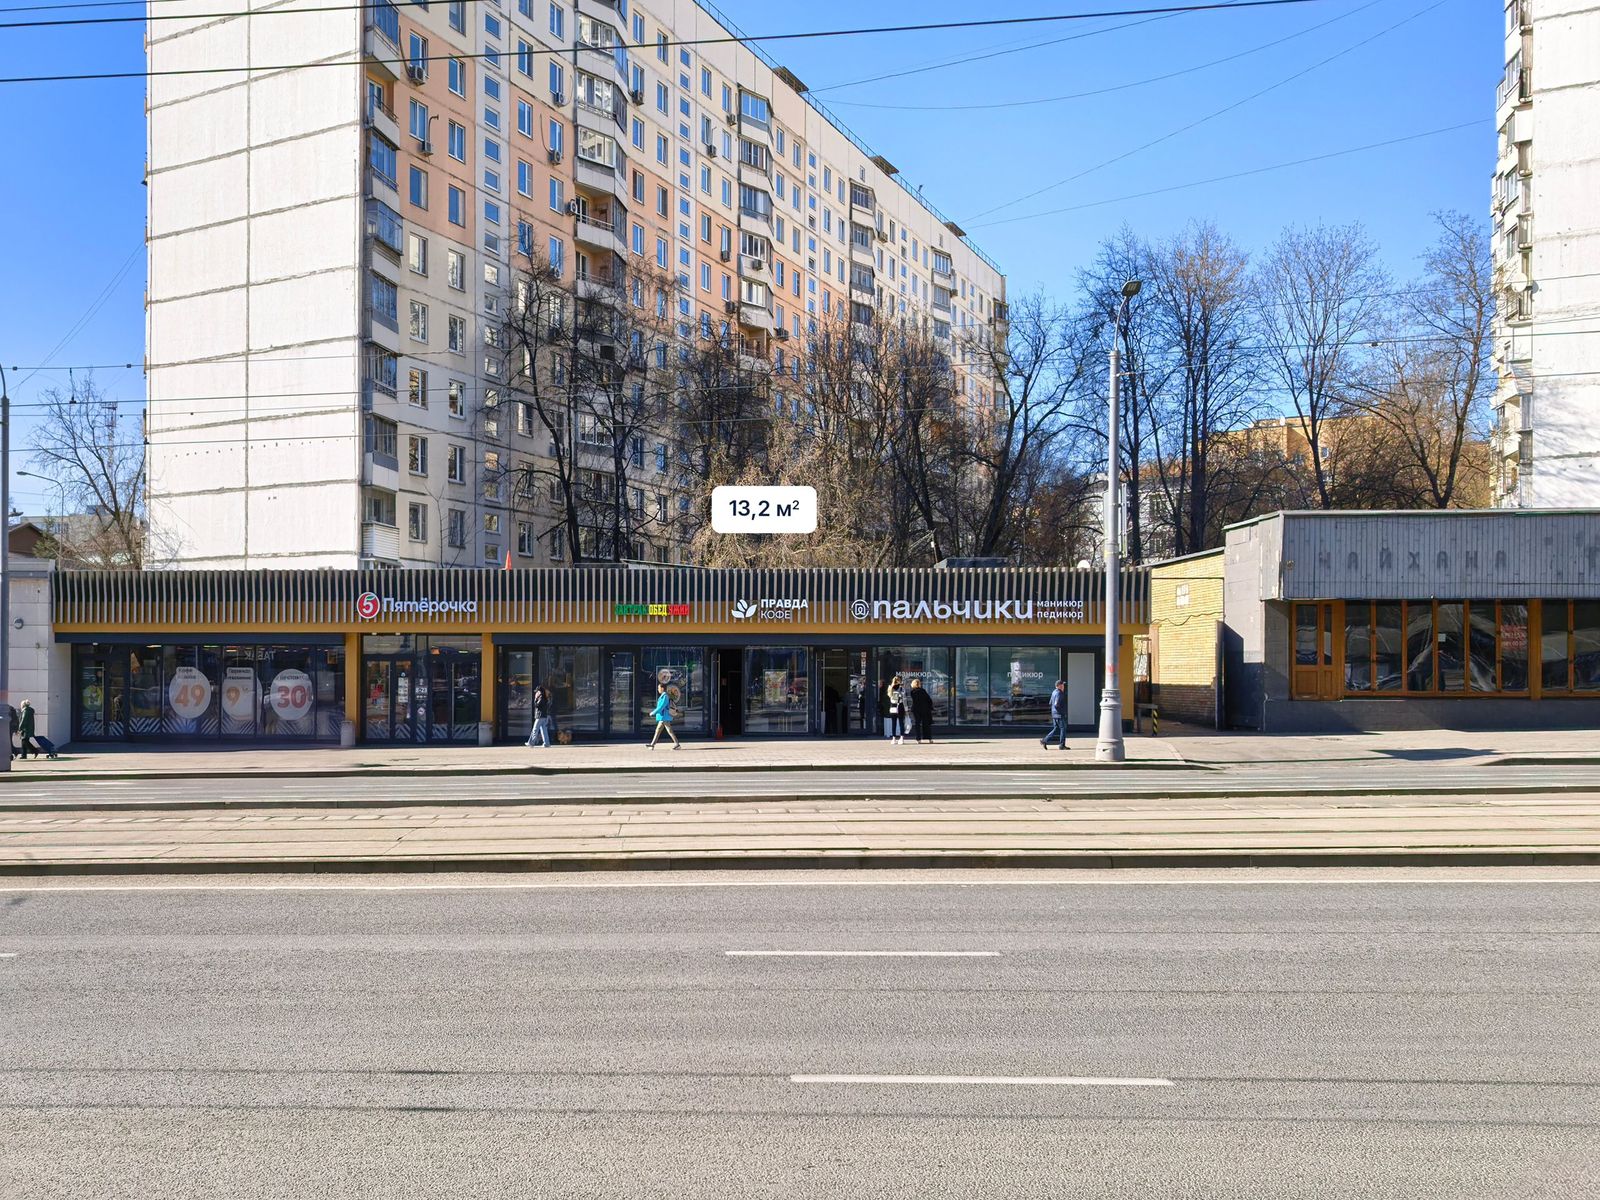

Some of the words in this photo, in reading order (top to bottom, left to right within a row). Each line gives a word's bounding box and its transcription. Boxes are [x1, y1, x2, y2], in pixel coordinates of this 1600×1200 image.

[1318, 547, 1507, 569] ЧАЙХАНА
[383, 597, 478, 616] Пятёрочка
[648, 604, 667, 616] ОБЕД
[760, 599, 809, 610] ПРАВДА
[873, 599, 1033, 619] пальчики
[1037, 600, 1084, 609] маникюр
[760, 610, 791, 619] КОФЕ
[1037, 610, 1084, 620] педикюр
[895, 671, 932, 680] маникюр
[1007, 671, 1044, 681] пикюр
[175, 684, 205, 708] 49
